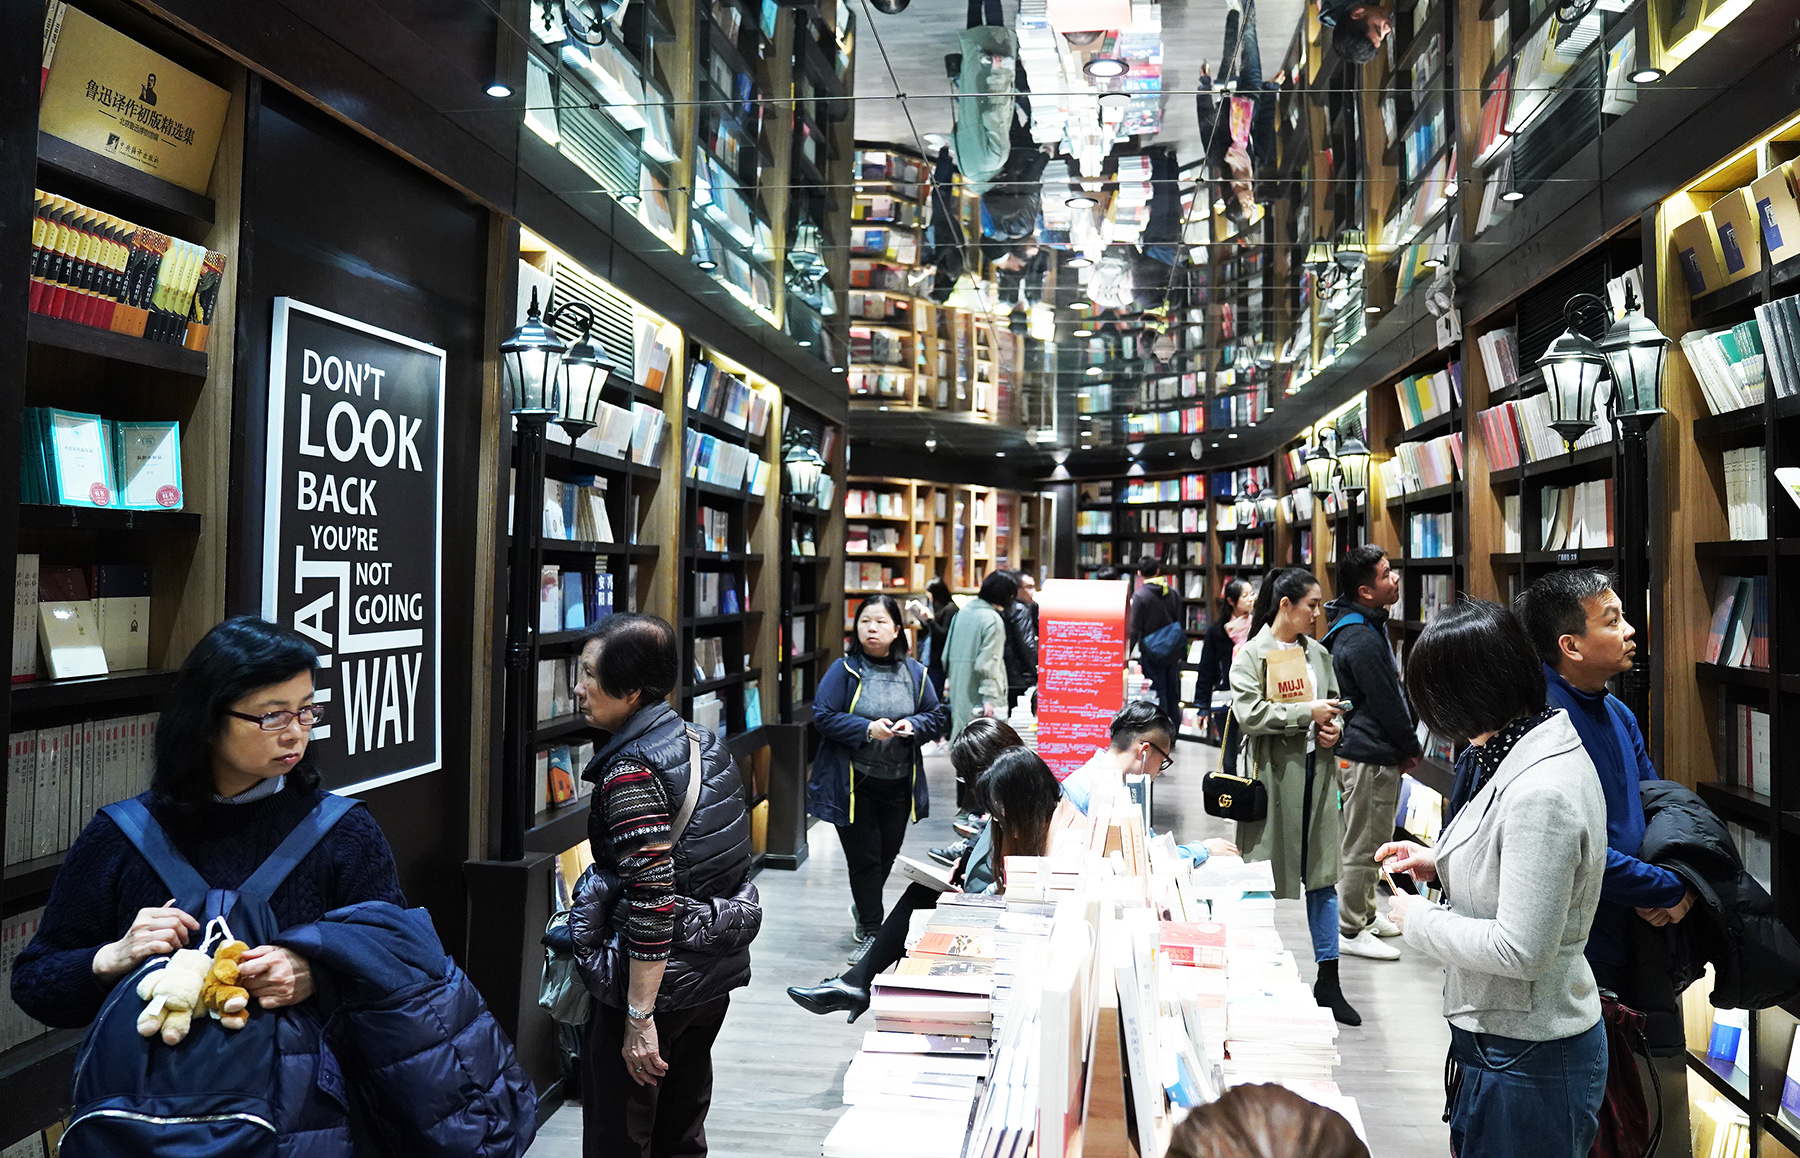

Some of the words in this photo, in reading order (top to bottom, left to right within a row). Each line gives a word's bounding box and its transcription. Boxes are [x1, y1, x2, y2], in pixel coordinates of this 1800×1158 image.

[85, 79, 195, 145] 鲁迅译作初版精选集
[302, 348, 386, 400] DON'T
[299, 393, 423, 472] LOOK
[297, 470, 377, 517] BACK
[310, 524, 378, 553] YOU'RE
[355, 562, 392, 585] NOT
[354, 593, 423, 625] GOING
[341, 652, 423, 756] WAY
[1278, 678, 1305, 694] MUJI
